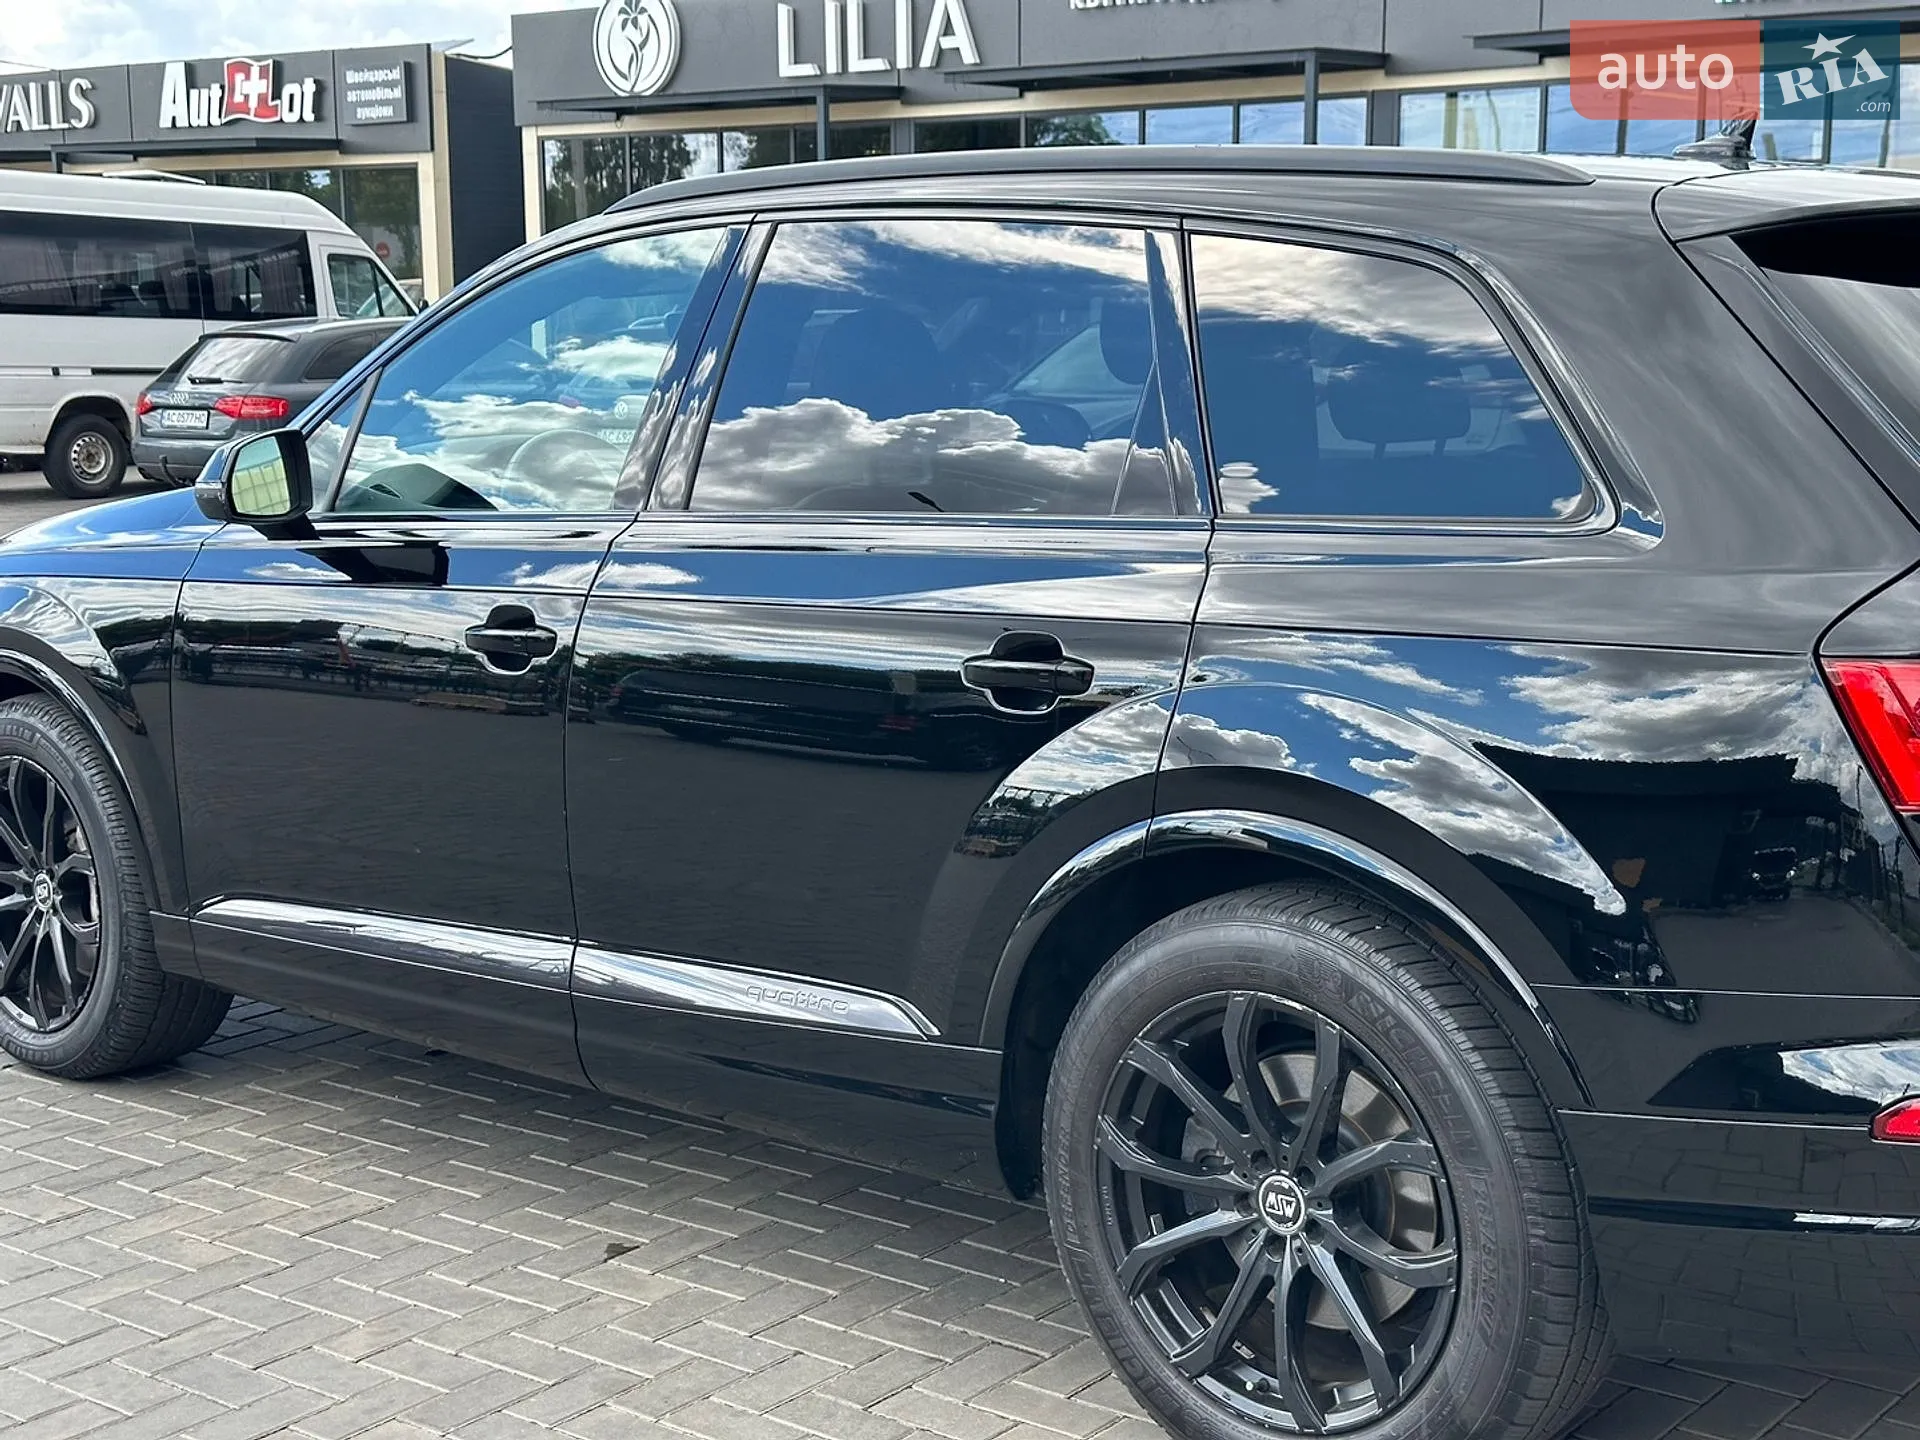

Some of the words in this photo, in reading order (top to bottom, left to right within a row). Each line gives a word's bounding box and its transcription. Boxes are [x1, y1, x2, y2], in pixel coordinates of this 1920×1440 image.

[778, 0, 980, 77] LILIA
[0, 77, 95, 133] ALLS
[746, 985, 849, 1015] quattro
